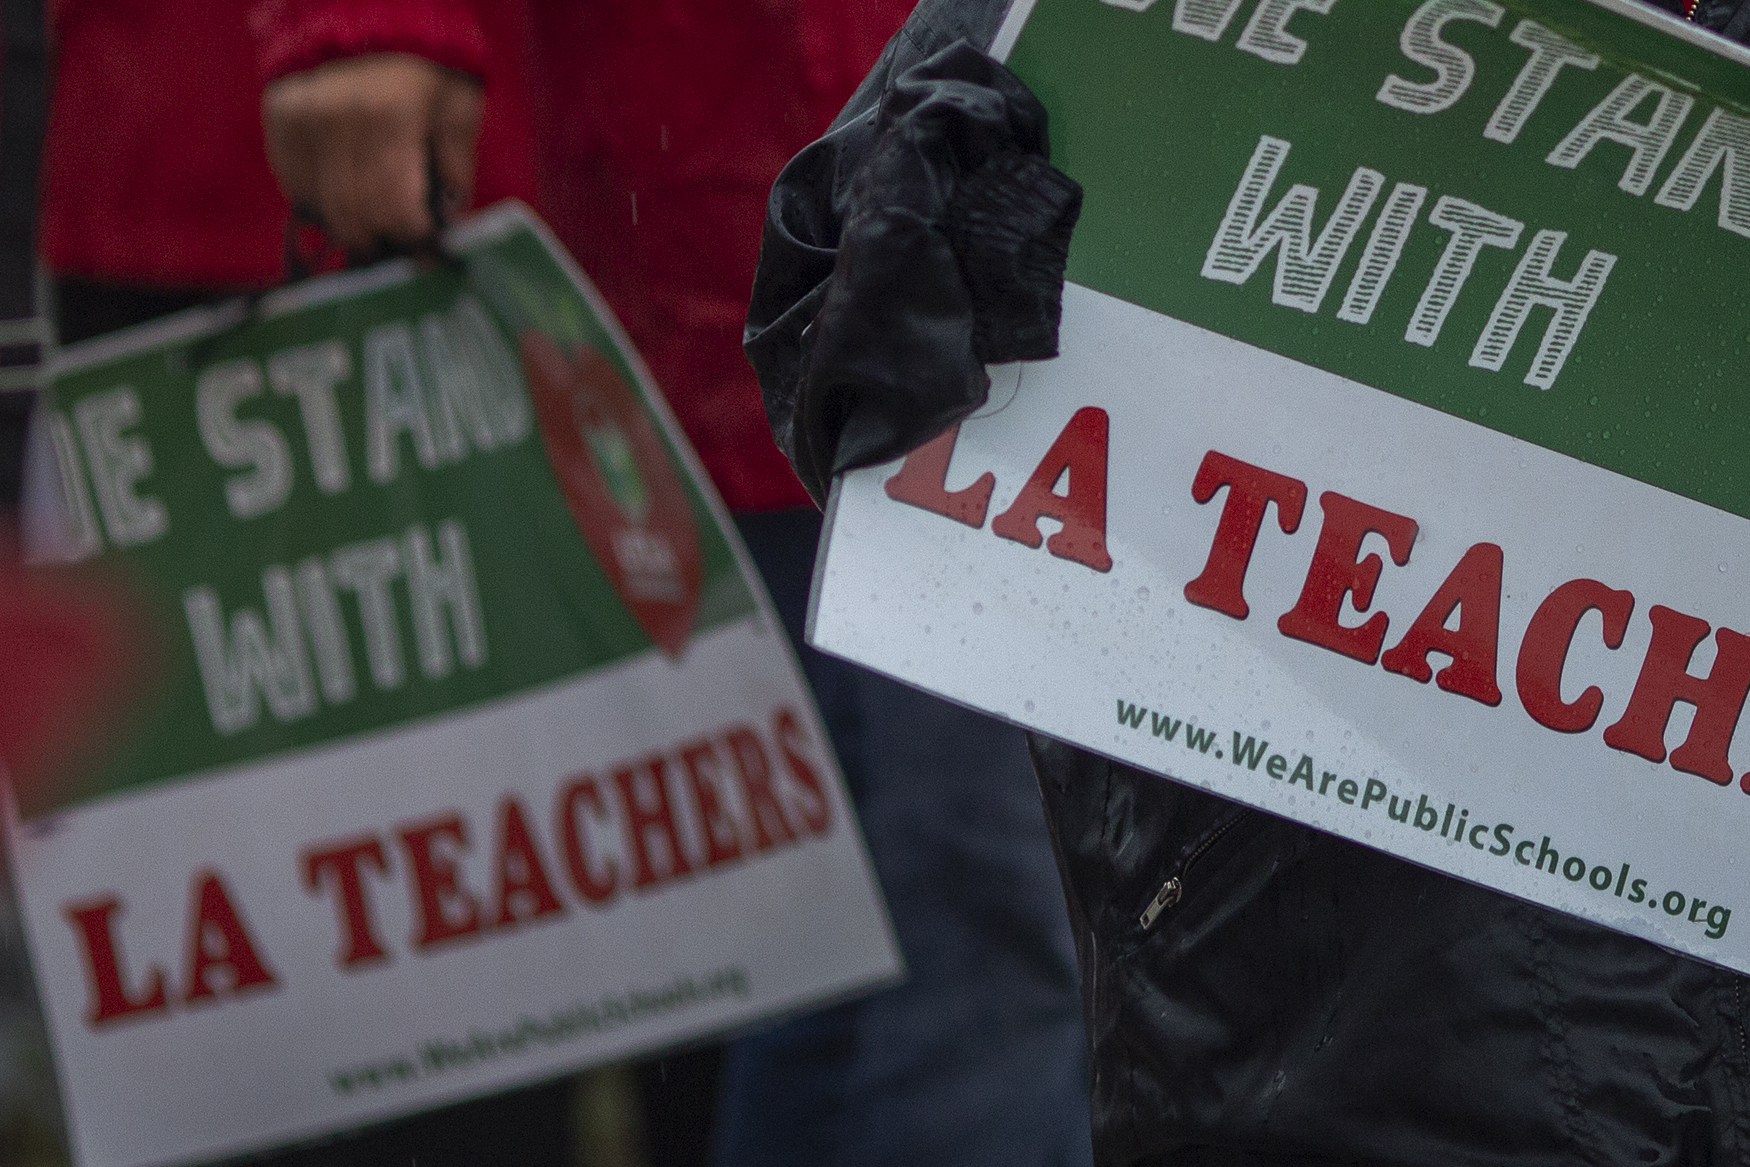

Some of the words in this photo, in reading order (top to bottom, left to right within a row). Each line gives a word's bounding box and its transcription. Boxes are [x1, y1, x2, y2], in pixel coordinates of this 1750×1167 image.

[1200, 134, 1617, 390] WITH
[184, 520, 489, 737] WITH
[64, 866, 282, 1029] LA
[300, 702, 833, 974] TEACHERS
[1116, 699, 1733, 939] www.WeArePublicSchools.org
